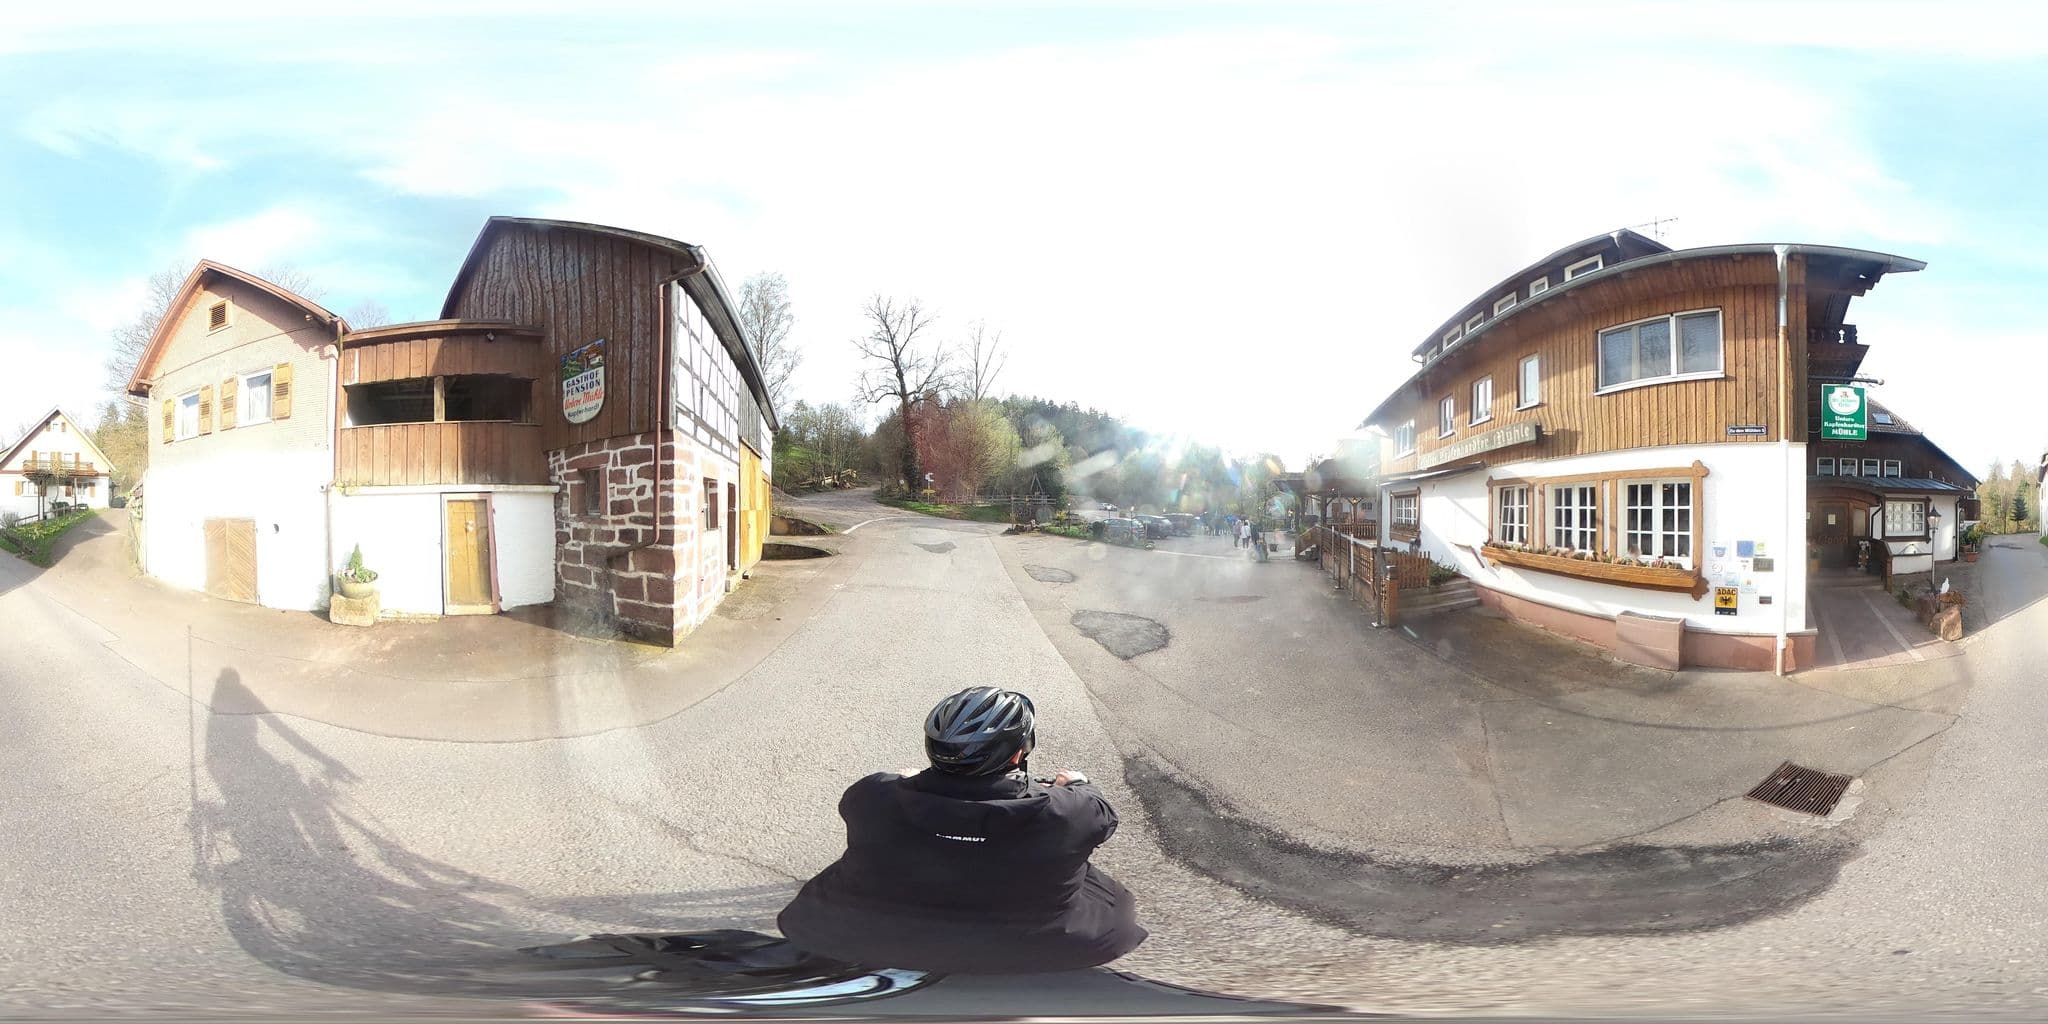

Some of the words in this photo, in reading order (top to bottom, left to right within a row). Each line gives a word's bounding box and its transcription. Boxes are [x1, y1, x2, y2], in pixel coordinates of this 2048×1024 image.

[566, 370, 600, 388] GASTHOF
[566, 379, 601, 398] PENSION
[1493, 425, 1530, 447] Mühle
[1831, 428, 1858, 436] MÜHLE
[1717, 588, 1737, 596] ADAC
